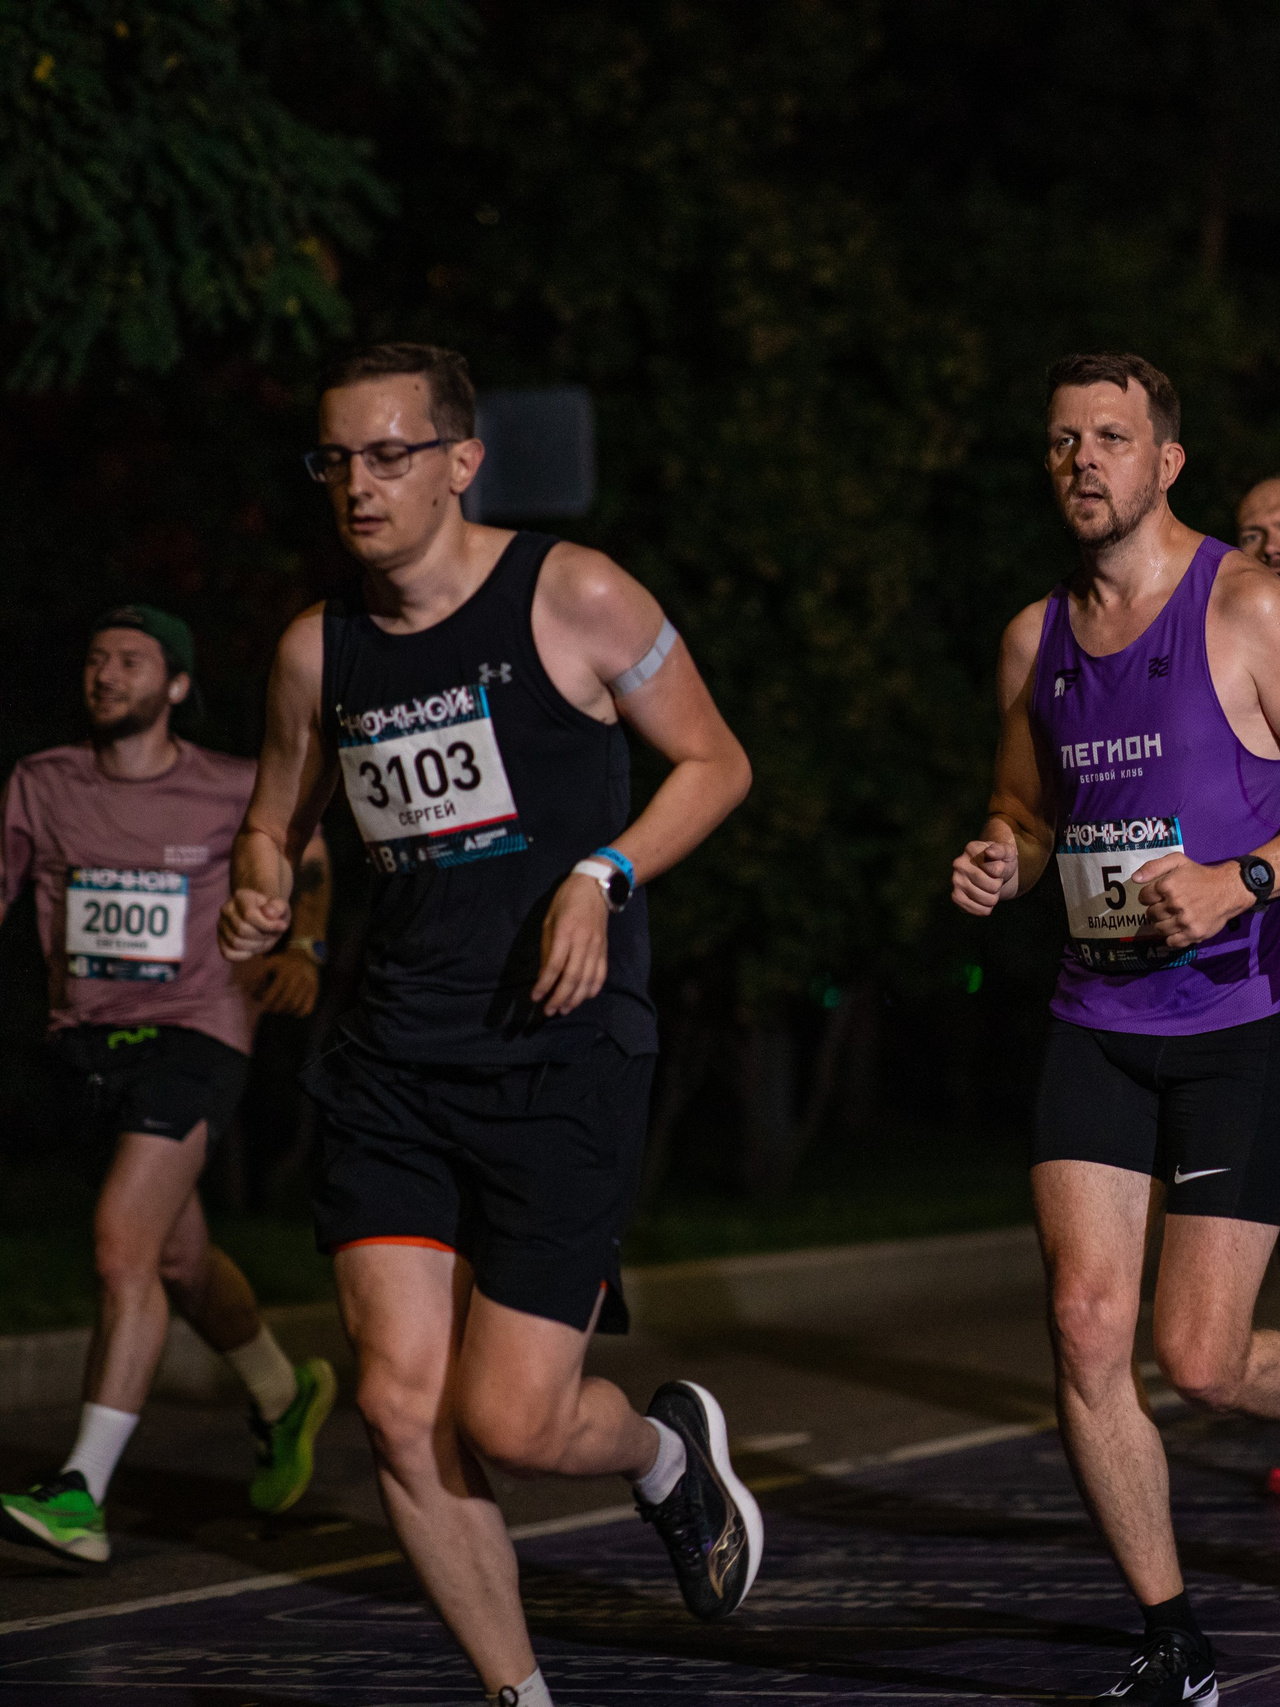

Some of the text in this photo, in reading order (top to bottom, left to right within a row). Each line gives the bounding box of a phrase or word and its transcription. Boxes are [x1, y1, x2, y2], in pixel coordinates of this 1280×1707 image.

[1061, 733, 1163, 769] ЛЕГИОН
[359, 741, 482, 809] 3103
[1079, 767, 1143, 784] БЕГОВОЙ КЛУБ
[398, 801, 456, 826] СЕРГЕЙ
[1101, 865, 1127, 910] 5
[83, 901, 170, 937] 2000
[1088, 912, 1152, 930] ВЛАДИМИ
